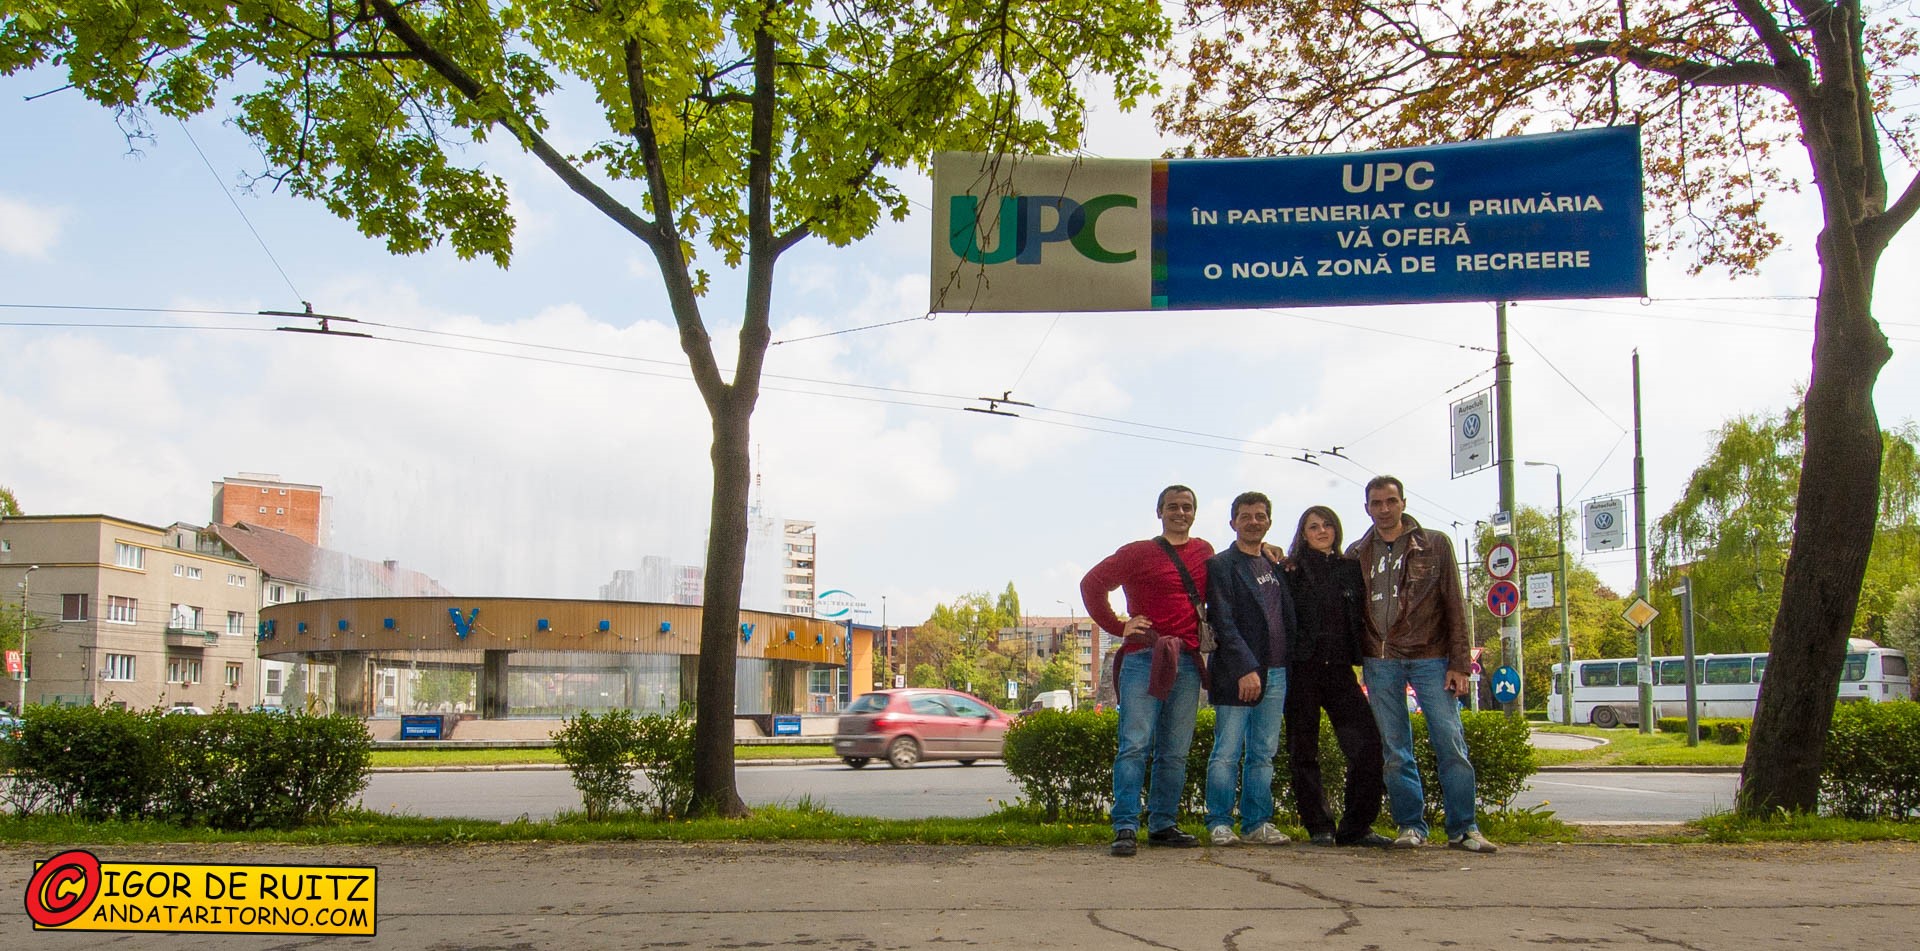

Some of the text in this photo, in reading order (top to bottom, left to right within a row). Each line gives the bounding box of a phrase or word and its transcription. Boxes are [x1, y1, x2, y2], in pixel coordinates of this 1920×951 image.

[1343, 161, 1434, 193] UPC
[1191, 192, 1602, 227] ÎN PARTENERIAT CU PRIMĂRIA
[950, 194, 1138, 264] UPC
[1337, 223, 1471, 248] VĂ OFERĂ
[1204, 251, 1590, 280] O NOUĂ ZONĂ DE RECREERE
[1458, 399, 1484, 413] Autoclub
[1590, 502, 1617, 510] Autoclub
